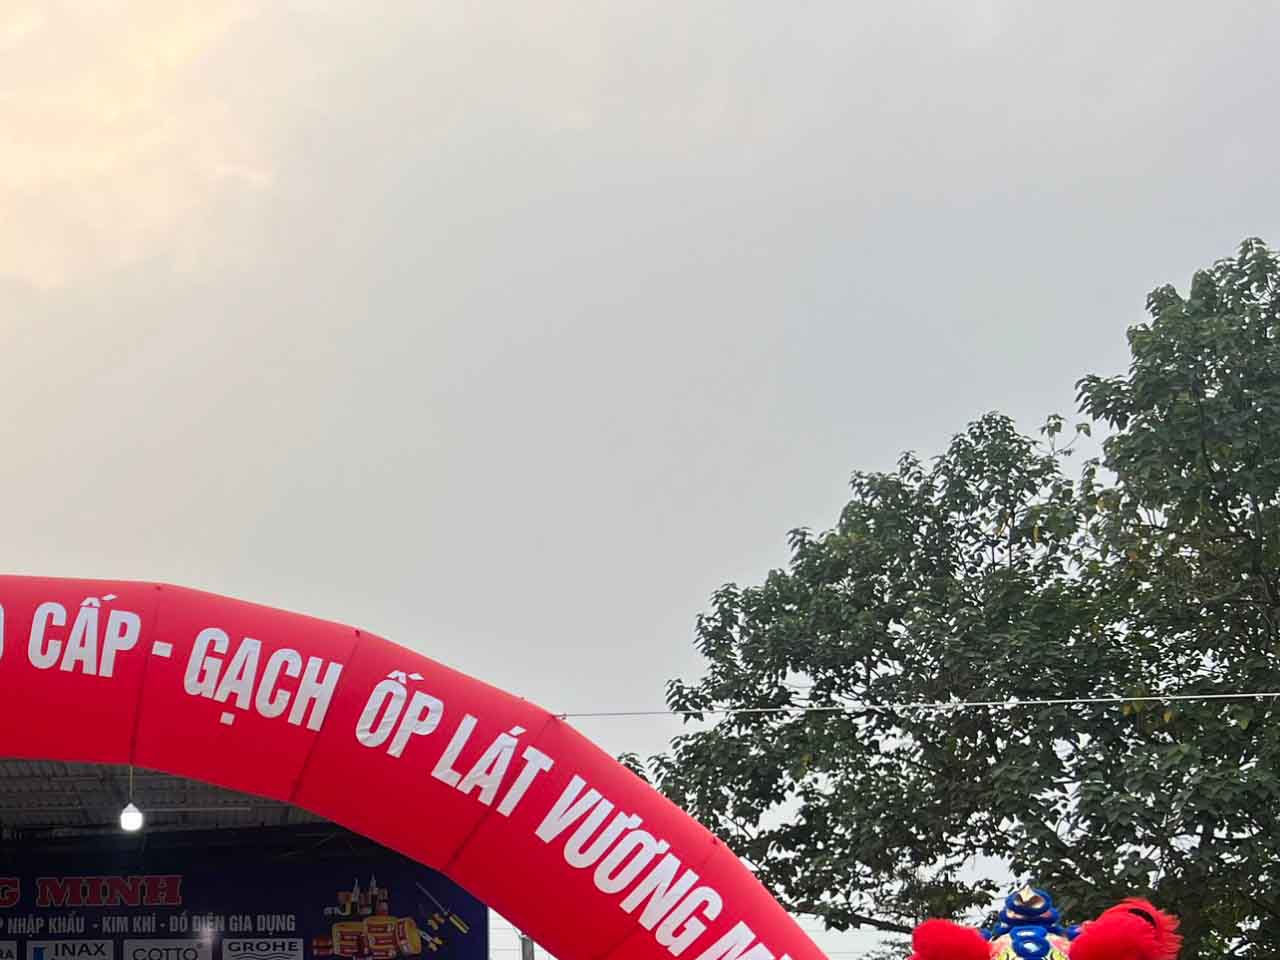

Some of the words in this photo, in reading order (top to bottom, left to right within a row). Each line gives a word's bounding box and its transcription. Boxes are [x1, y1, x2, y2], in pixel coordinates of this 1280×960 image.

[28, 593, 142, 678] CẤP
[184, 627, 343, 731] GẠCH
[355, 670, 445, 759] ỐP
[432, 713, 554, 818] LÁT
[535, 772, 724, 957] VƯƠNG
[35, 874, 184, 908] MINH
[8, 913, 44, 938] NHẬP
[102, 915, 129, 934] KIM
[229, 914, 253, 933] GIA
[257, 914, 296, 936] DỤNG
[55, 943, 106, 957] INAX
[228, 942, 299, 952] GROHE
